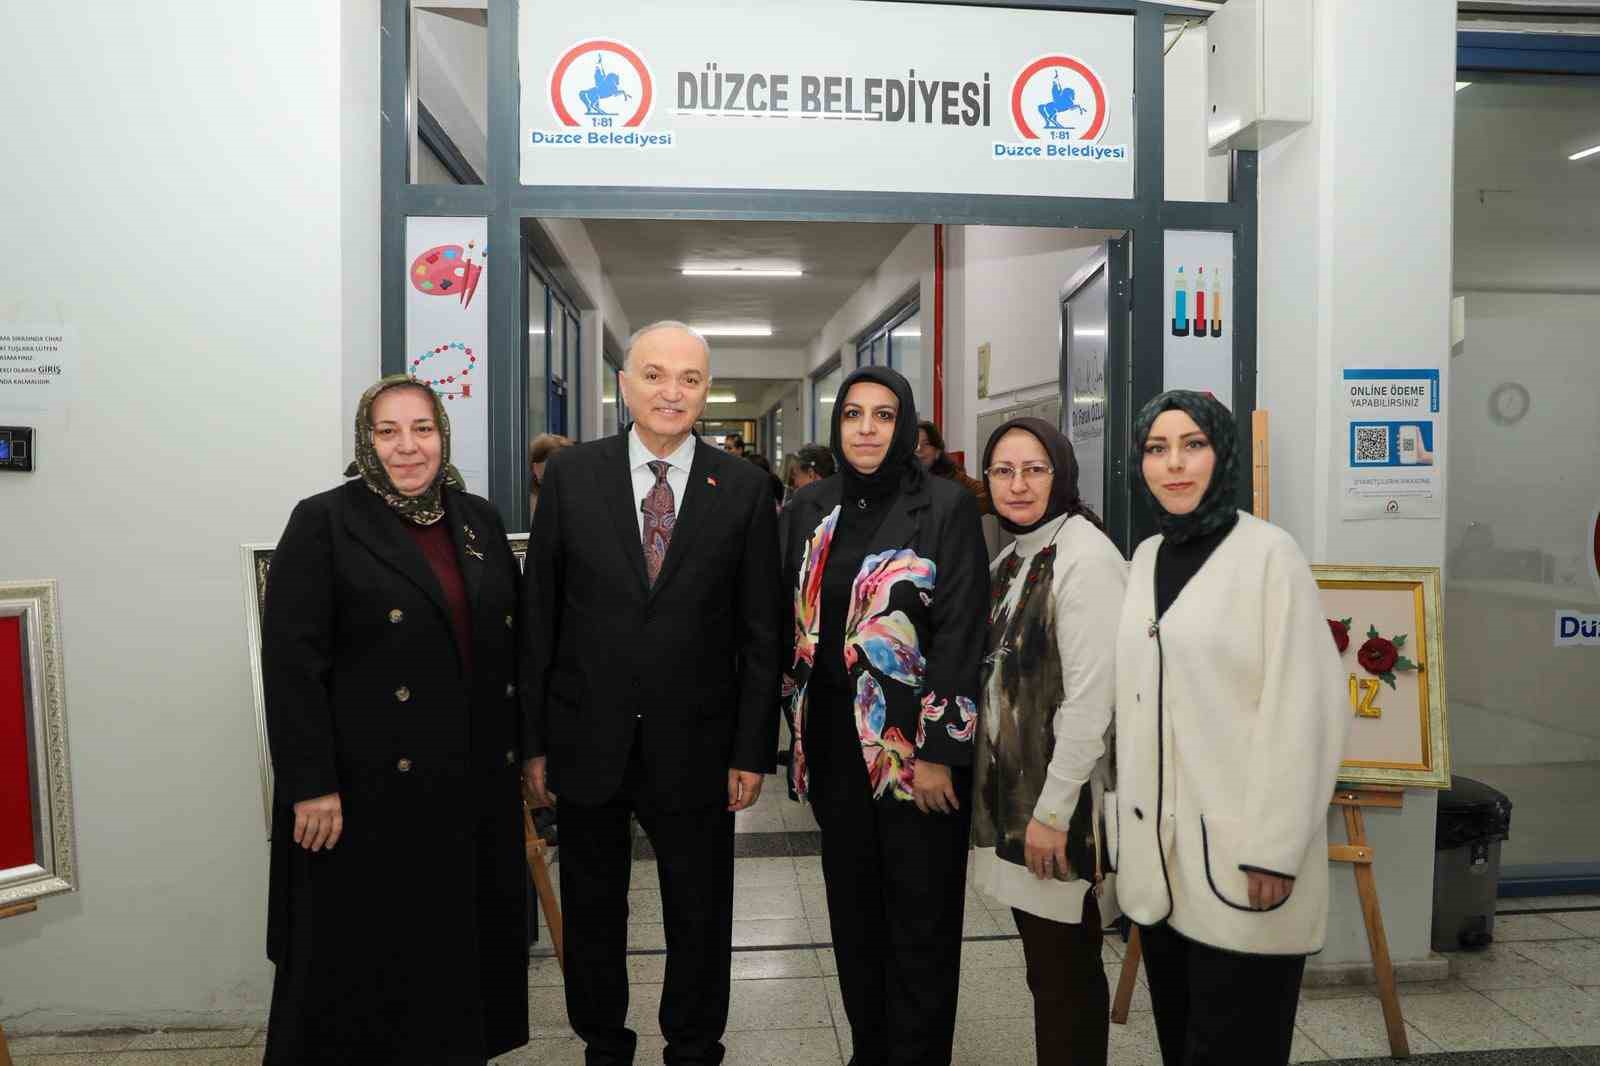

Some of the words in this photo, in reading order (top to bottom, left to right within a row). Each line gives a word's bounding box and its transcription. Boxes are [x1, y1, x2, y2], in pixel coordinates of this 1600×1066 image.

[677, 62, 789, 118] DÜZCE
[801, 68, 991, 126] BELEDİYESİ
[532, 131, 582, 144] Düzce
[587, 132, 672, 147] Belediyesi
[994, 144, 1042, 156] Düzce
[1047, 144, 1125, 159] Belediyesi
[38, 364, 62, 375] GİRİŞ
[1351, 384, 1387, 396] ONLİNE
[1391, 384, 1424, 396] ÖDEME
[1351, 398, 1418, 408] YAPABİLİRSİNİZ
[1560, 616, 1600, 639] Dü
